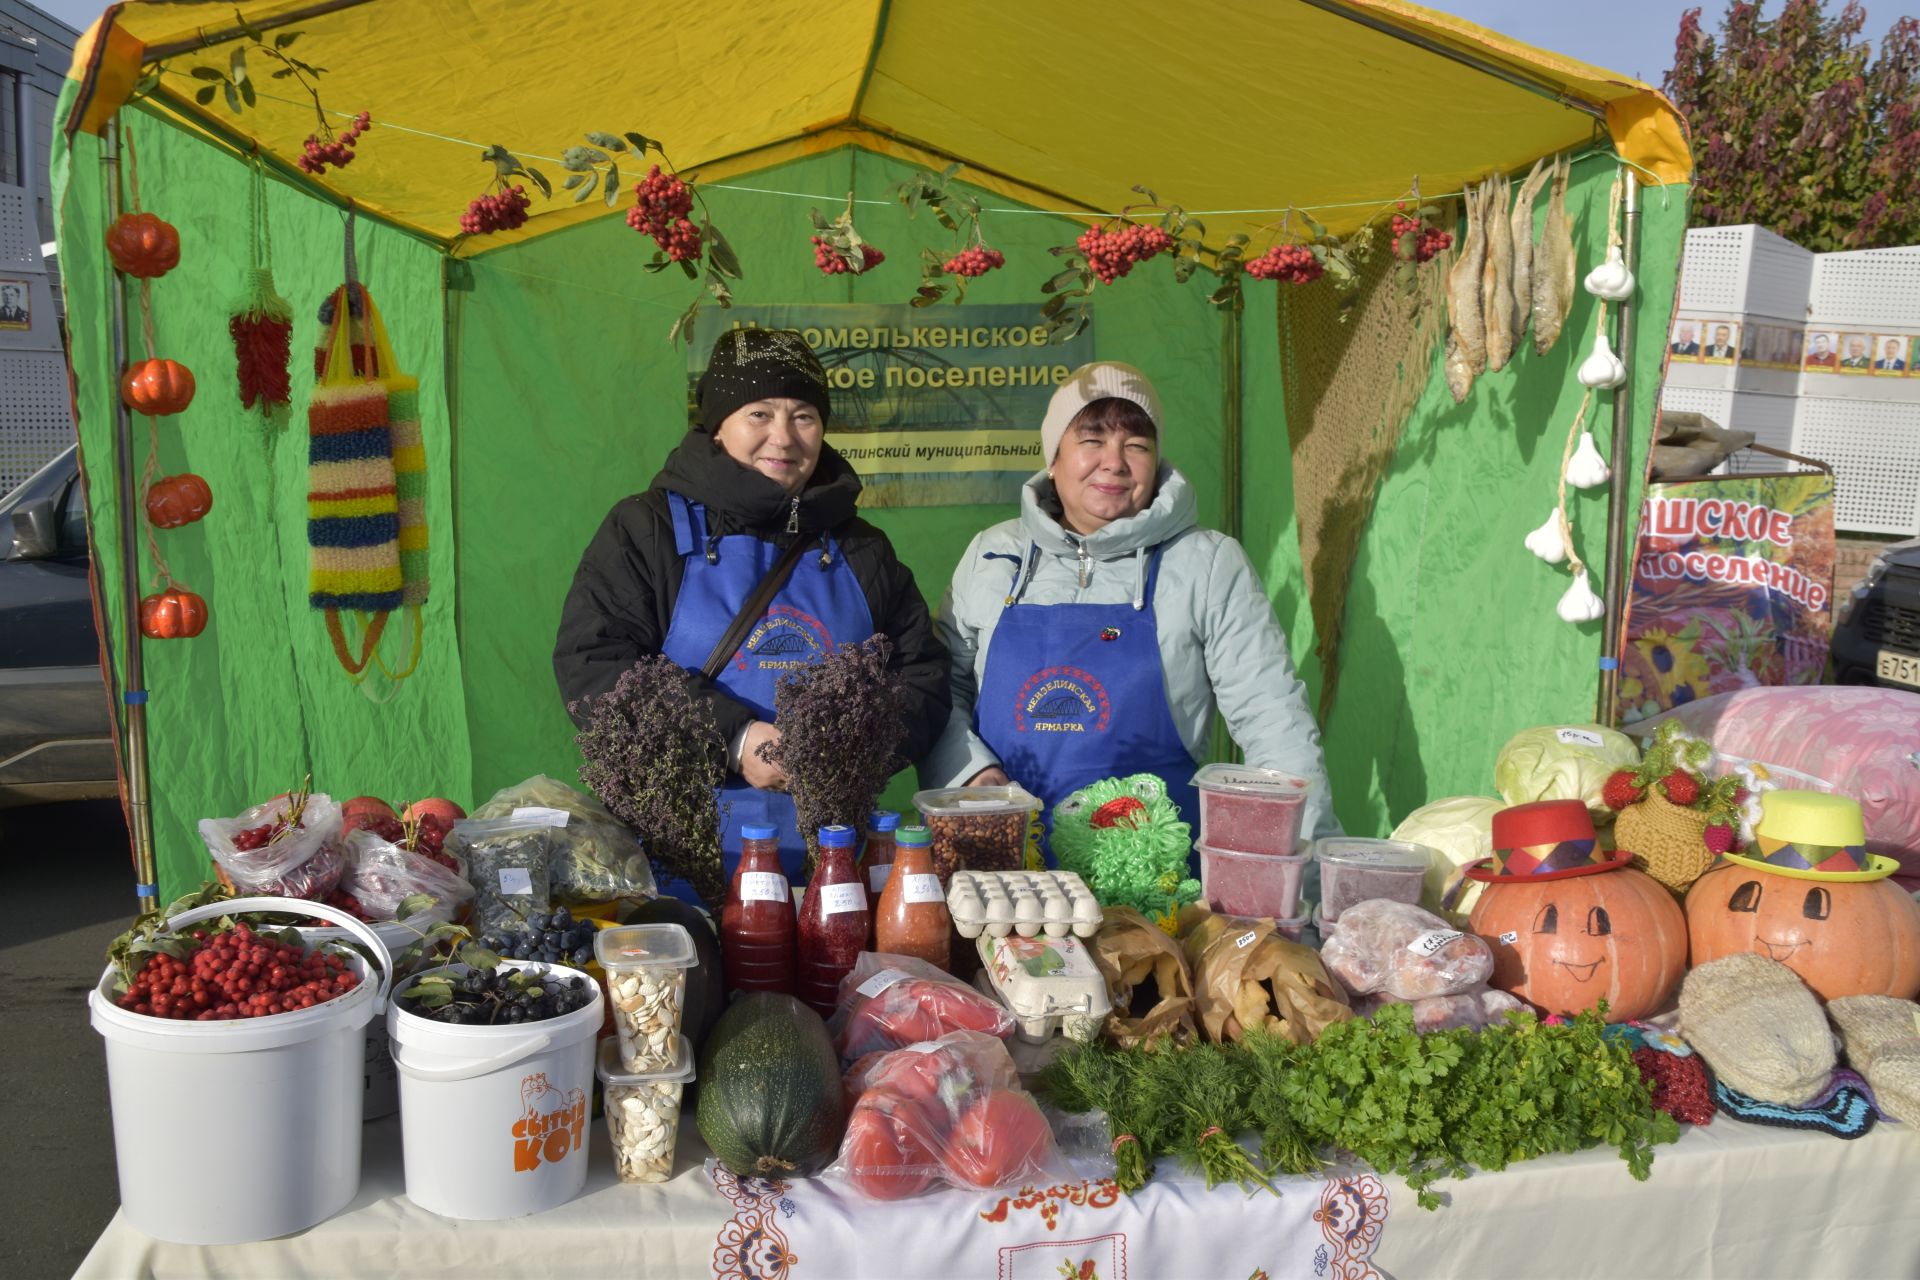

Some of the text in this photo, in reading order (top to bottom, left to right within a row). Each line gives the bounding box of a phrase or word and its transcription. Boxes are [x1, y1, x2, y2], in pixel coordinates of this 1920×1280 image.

[885, 364, 1070, 389] поселение
[915, 441, 1041, 461] муниципальный
[1641, 553, 1826, 612] поселение
[1026, 679, 1096, 713] МЕНЗЕЛИНСКАЯ
[1034, 722, 1085, 732] ЯРМАРКА
[511, 1094, 586, 1138] СЫТЫЙ
[514, 1116, 585, 1172] КОТ
